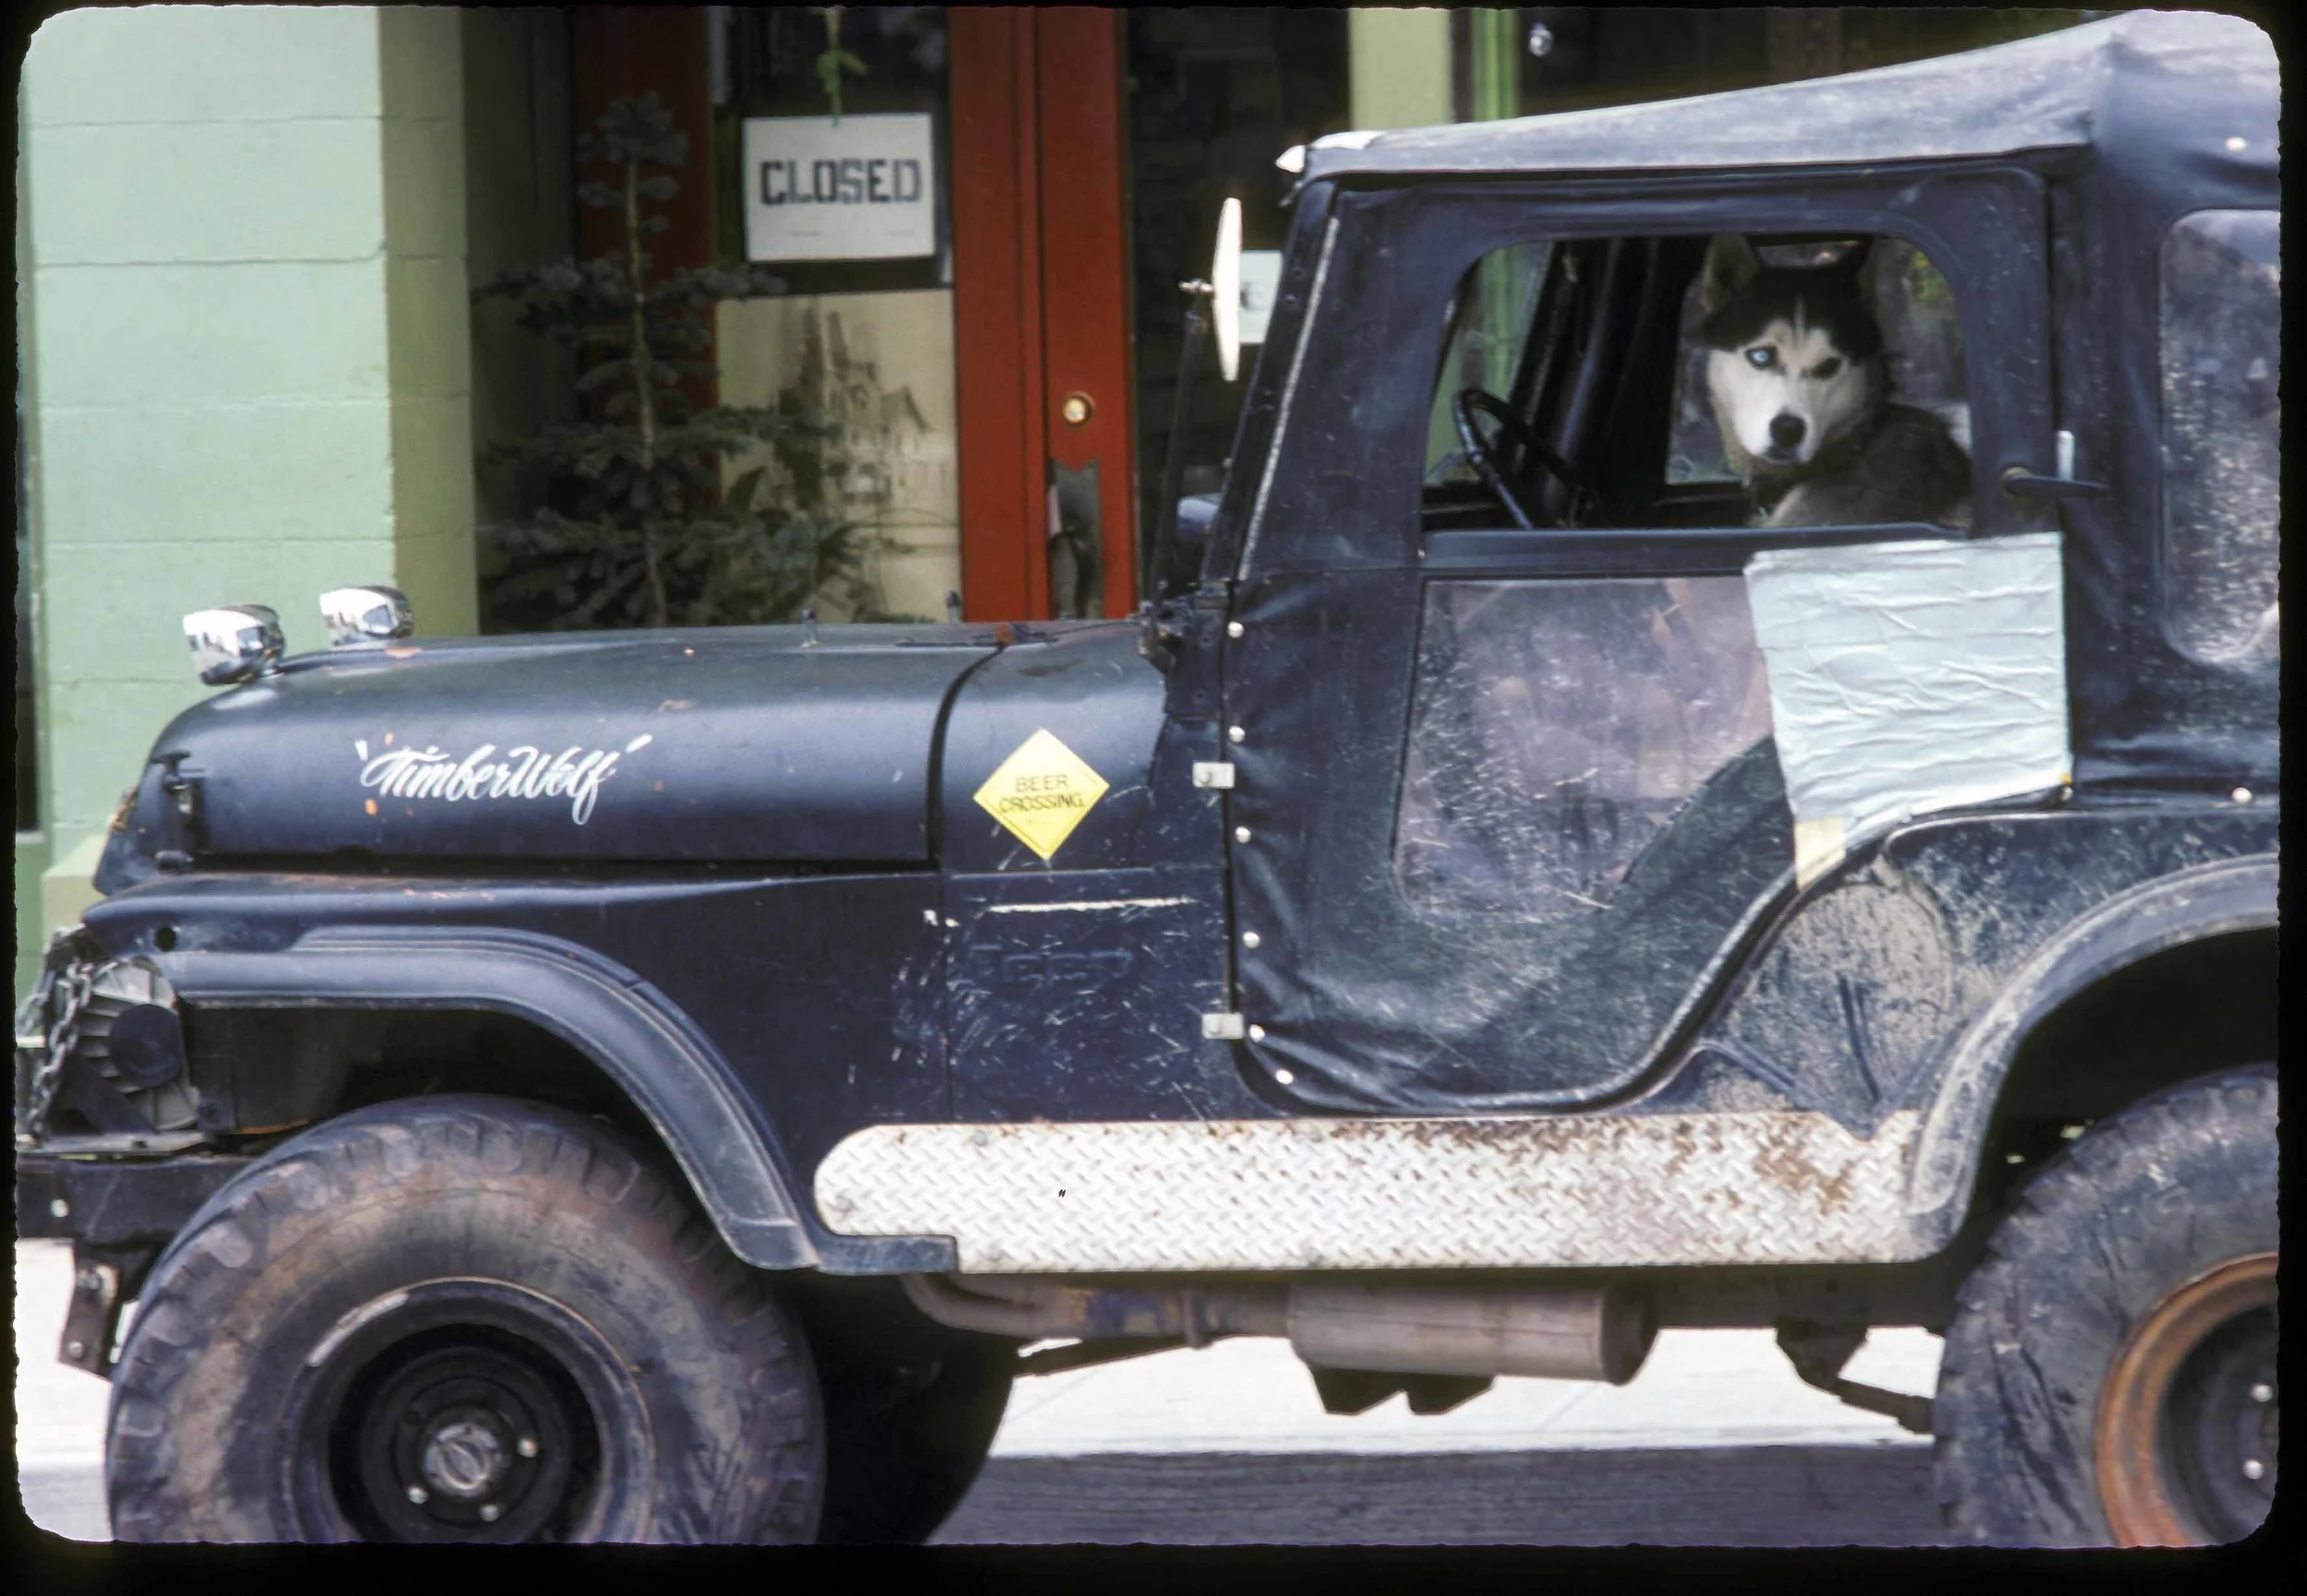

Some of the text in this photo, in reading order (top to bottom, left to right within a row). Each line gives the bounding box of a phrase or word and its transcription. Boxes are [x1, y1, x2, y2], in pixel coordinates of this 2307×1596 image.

[759, 158, 921, 205] CLOSED
[1016, 774, 1069, 792] BEER
[999, 792, 1084, 813] CROSSING
